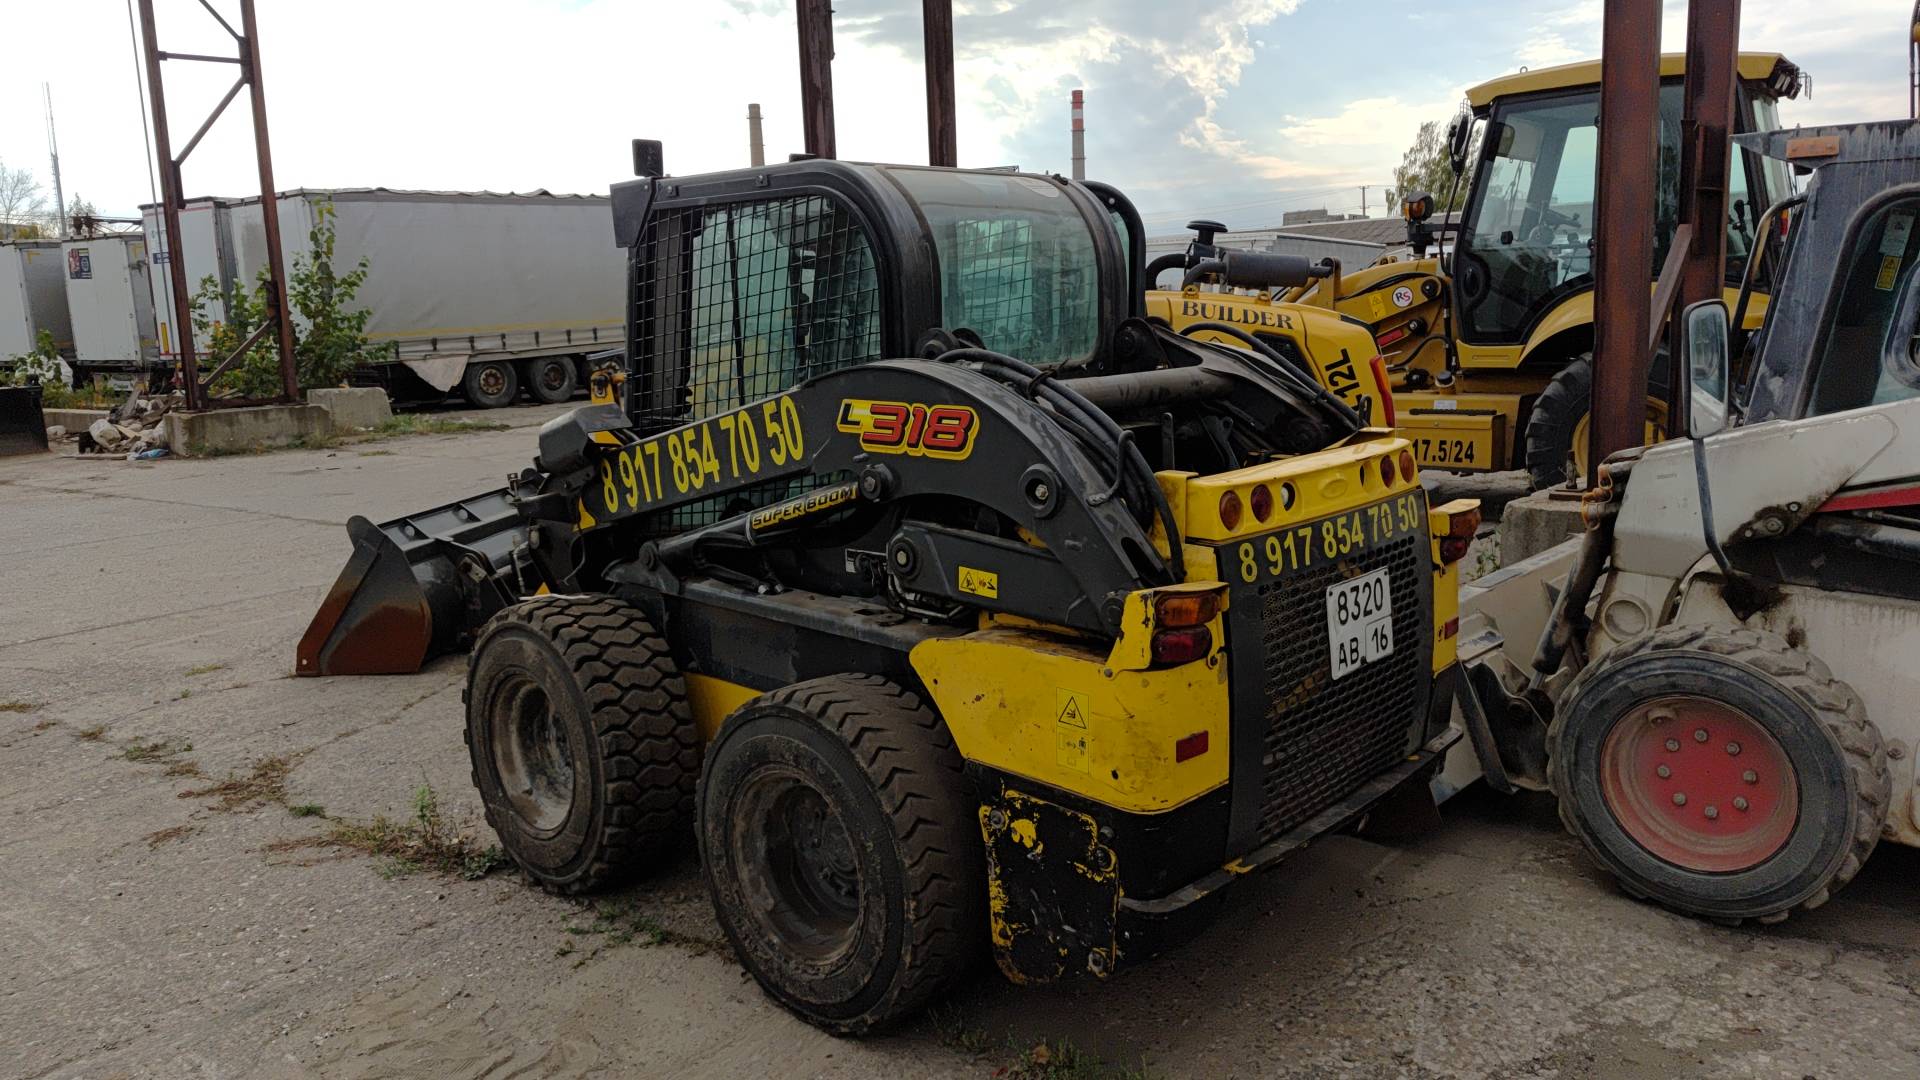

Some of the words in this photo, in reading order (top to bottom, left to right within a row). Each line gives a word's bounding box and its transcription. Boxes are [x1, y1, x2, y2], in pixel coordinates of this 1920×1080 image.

[1395, 290, 1411, 302] RS
[1182, 300, 1294, 330] BUILDER
[601, 457, 619, 513] 8
[619, 440, 663, 508] 917
[667, 422, 720, 494] 854
[719, 409, 760, 478] 70
[762, 395, 804, 466] 50
[1412, 438, 1475, 464] 17.5/24
[752, 502, 806, 529] SUPER
[806, 484, 858, 512] BOOM
[1239, 542, 1258, 583] 8
[1265, 526, 1312, 576] 917
[1321, 511, 1365, 559] 854
[1367, 502, 1393, 542] 70
[1397, 494, 1418, 533] 50
[1337, 577, 1384, 626] 8320
[1371, 624, 1389, 654] 16
